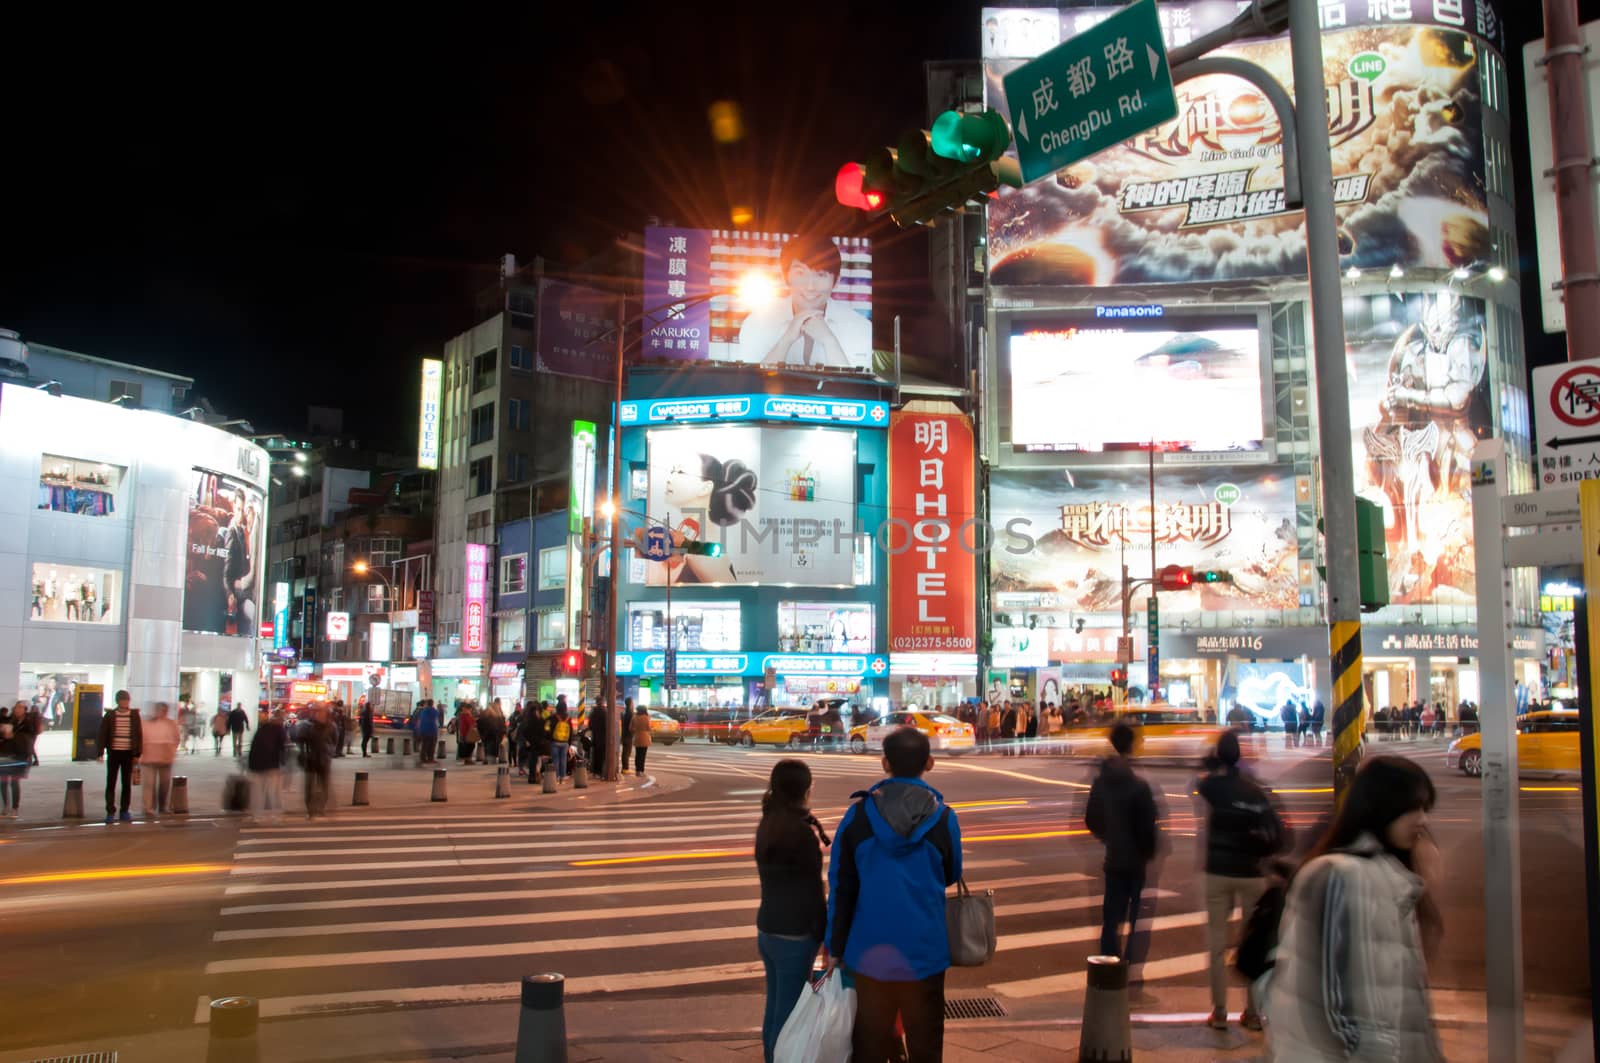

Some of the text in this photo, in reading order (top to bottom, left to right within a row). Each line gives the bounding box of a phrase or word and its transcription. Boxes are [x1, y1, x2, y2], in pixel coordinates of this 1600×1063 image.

[1354, 60, 1383, 74] LINE
[1031, 37, 1135, 120] 成都路
[1040, 89, 1148, 154] ChengDu Rd.
[1124, 170, 1248, 208] 神的降臨
[1096, 305, 1164, 318] Panasonic
[651, 327, 701, 338] NARUKO
[657, 403, 711, 416] watsons
[773, 402, 827, 415] watsons
[424, 402, 435, 450] HOTEL
[1513, 503, 1539, 515] 90m
[192, 543, 206, 553] Fall
[893, 637, 972, 649] (02)2375-5500
